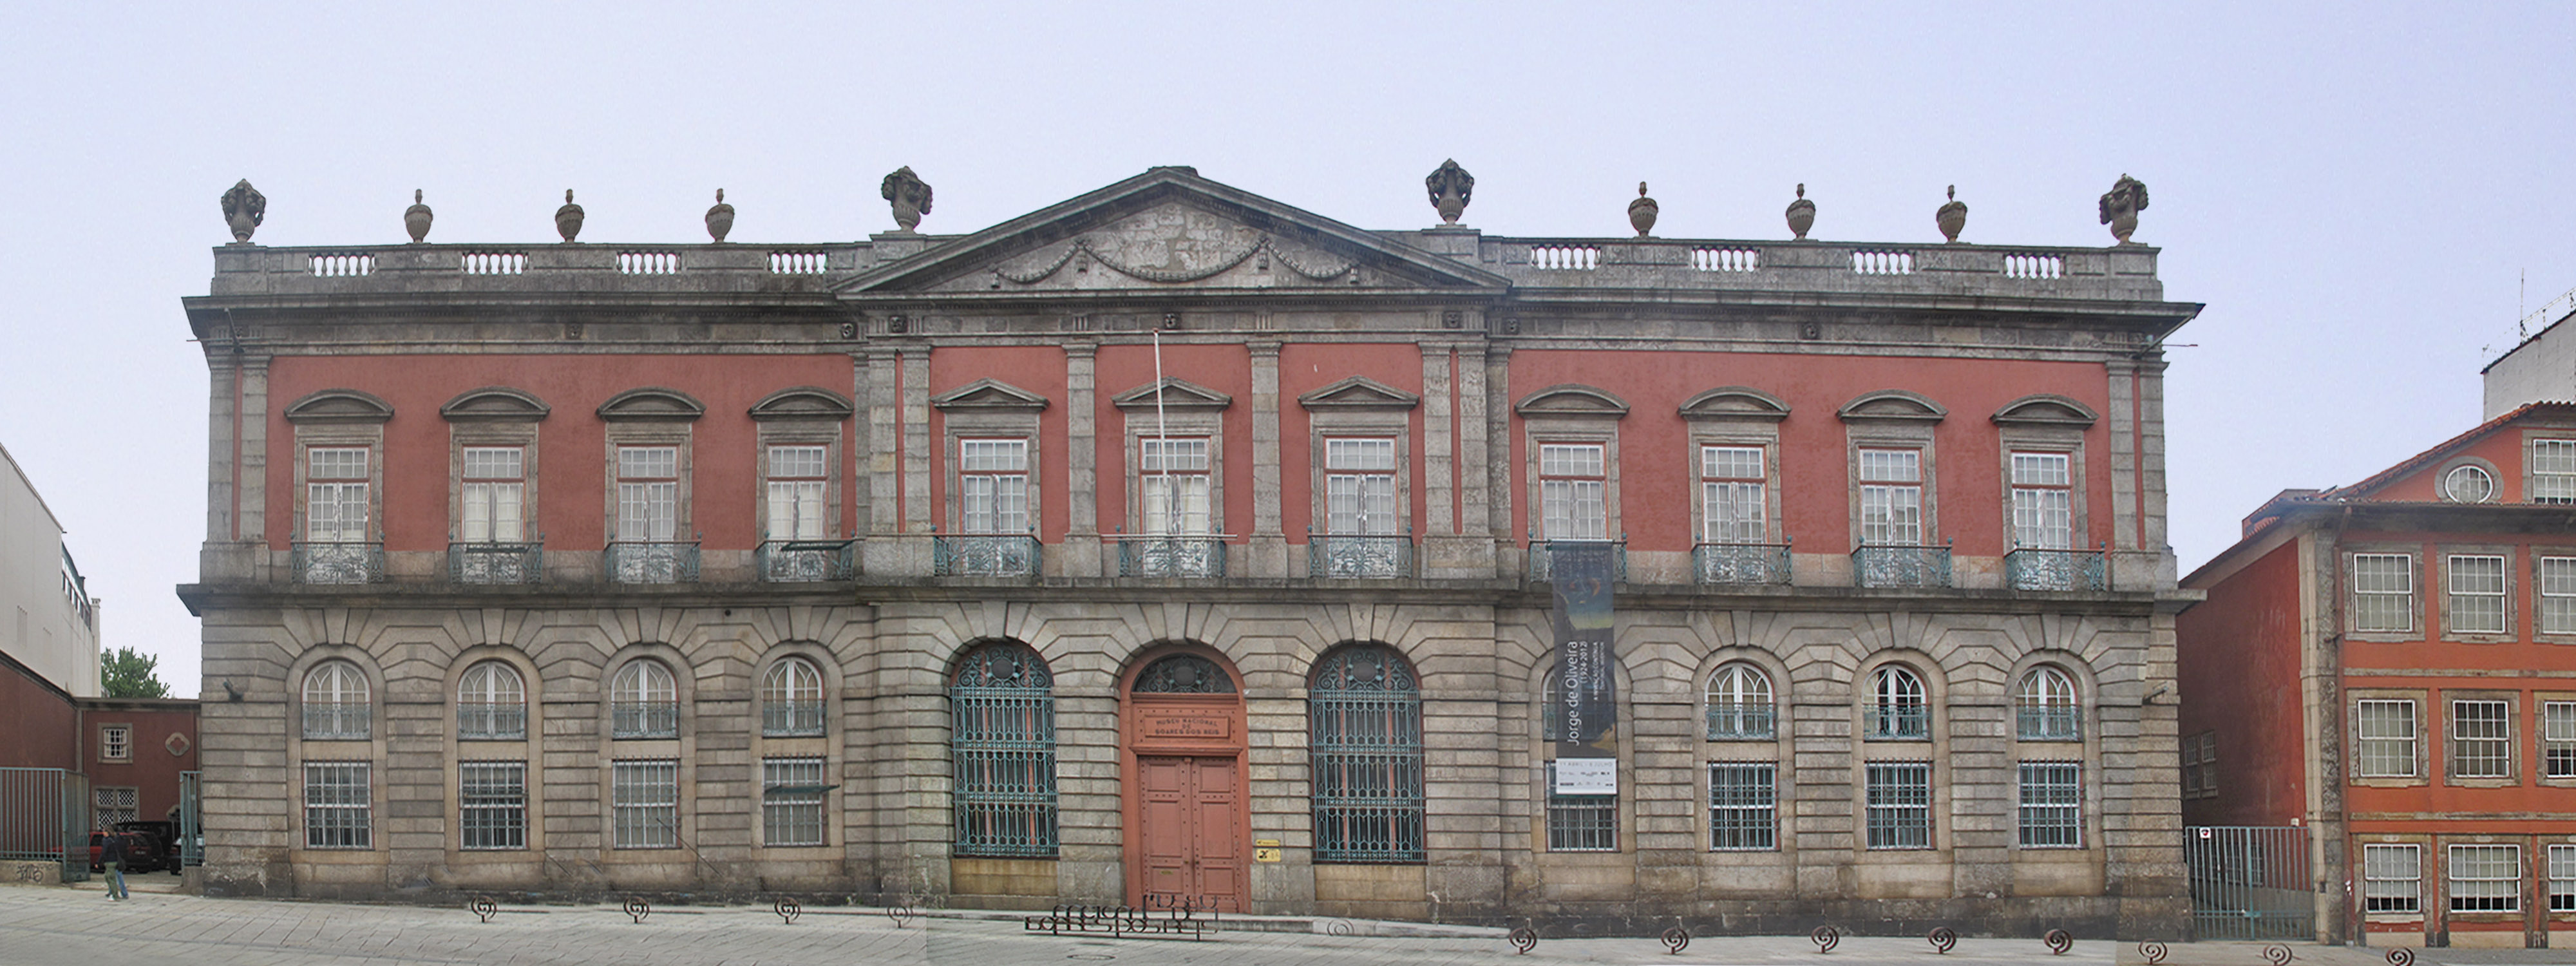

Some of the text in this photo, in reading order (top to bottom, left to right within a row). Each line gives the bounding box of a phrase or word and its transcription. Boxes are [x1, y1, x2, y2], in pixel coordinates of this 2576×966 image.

[1565, 641, 1582, 746] Jorge de Oliveira
[1182, 718, 1218, 726] NACIONAL
